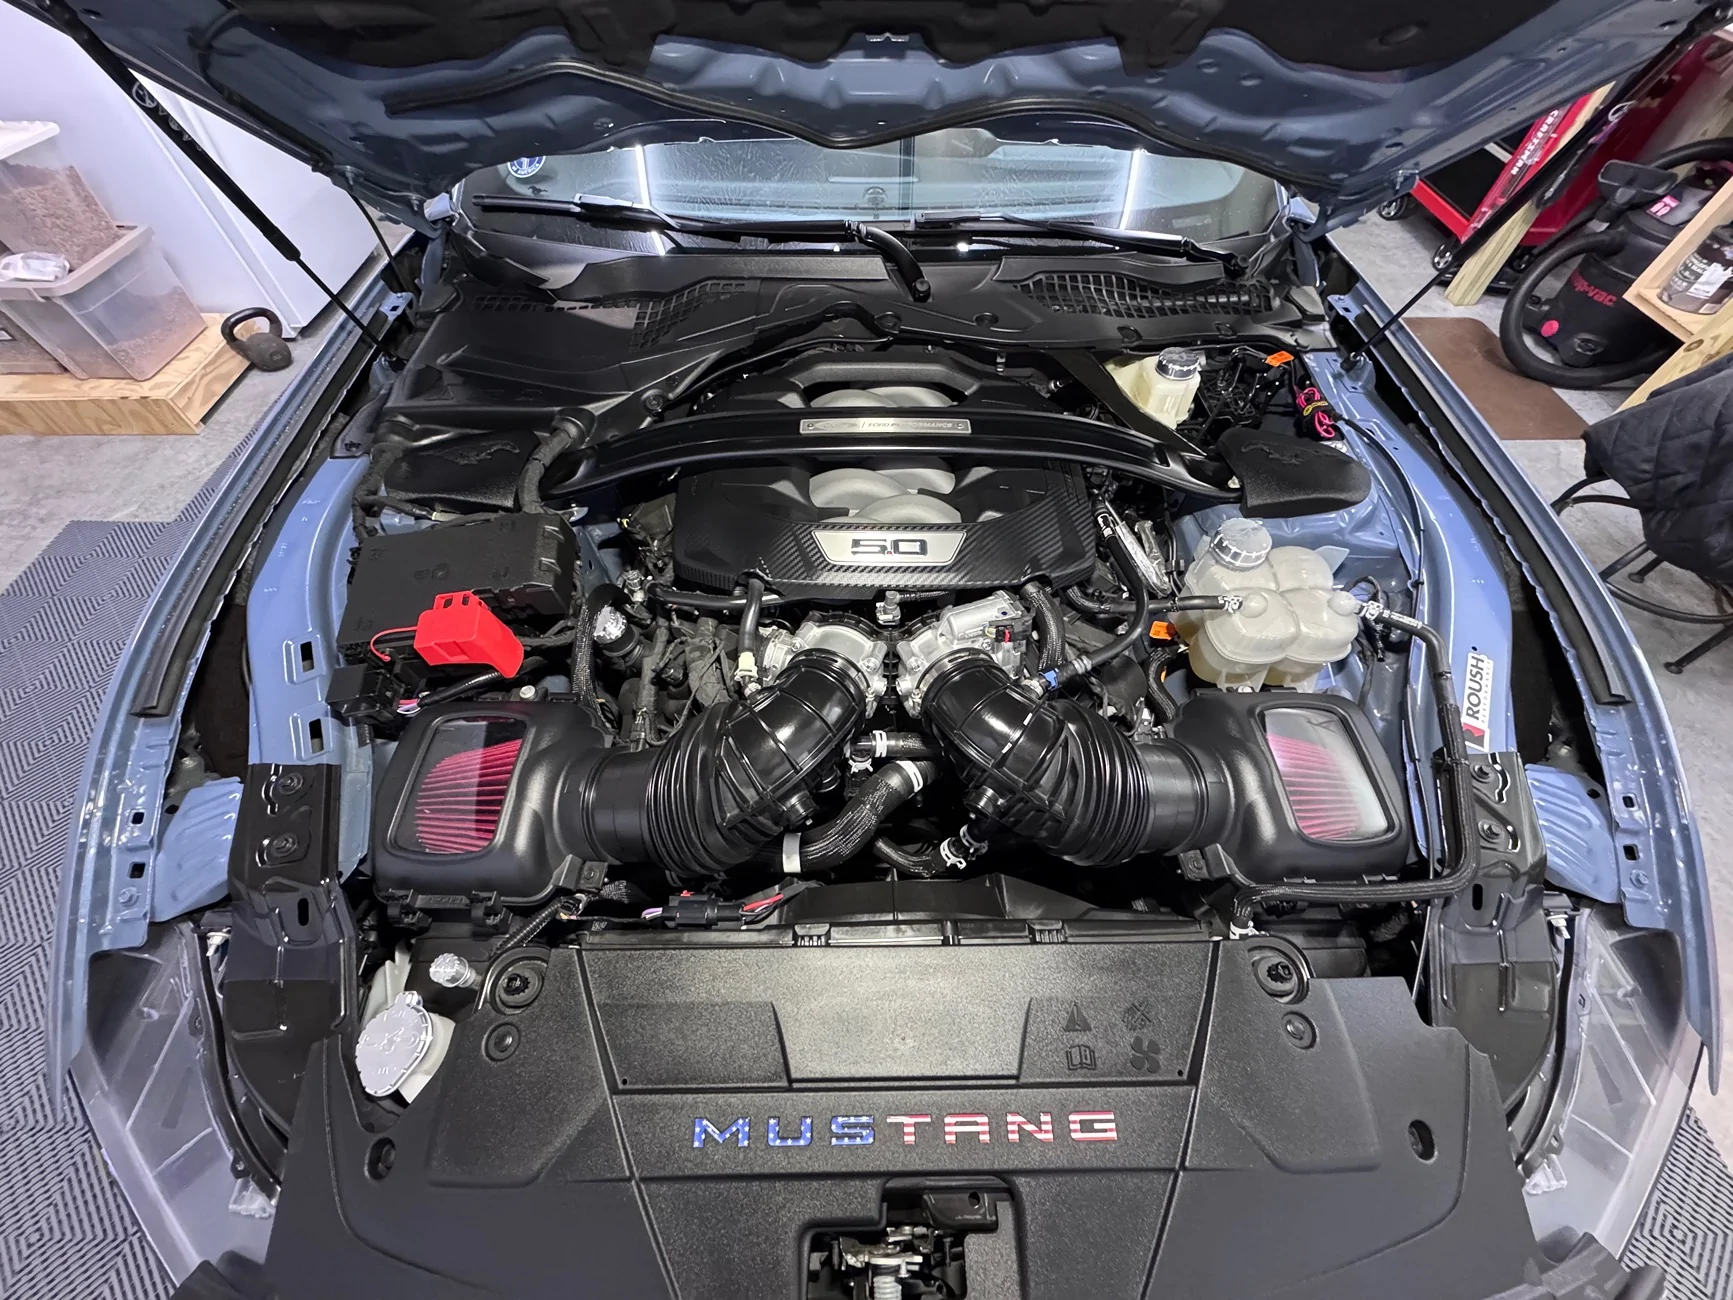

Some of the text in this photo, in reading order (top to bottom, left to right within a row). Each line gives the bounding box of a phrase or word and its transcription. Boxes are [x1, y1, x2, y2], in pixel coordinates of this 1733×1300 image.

[1511, 110, 1559, 175] CRAFTSMAN
[851, 538, 928, 556] 5.0
[1466, 655, 1485, 721] ROUSH
[1481, 661, 1491, 723] PERFORMANCE
[692, 1111, 1118, 1148] MUSTANG
